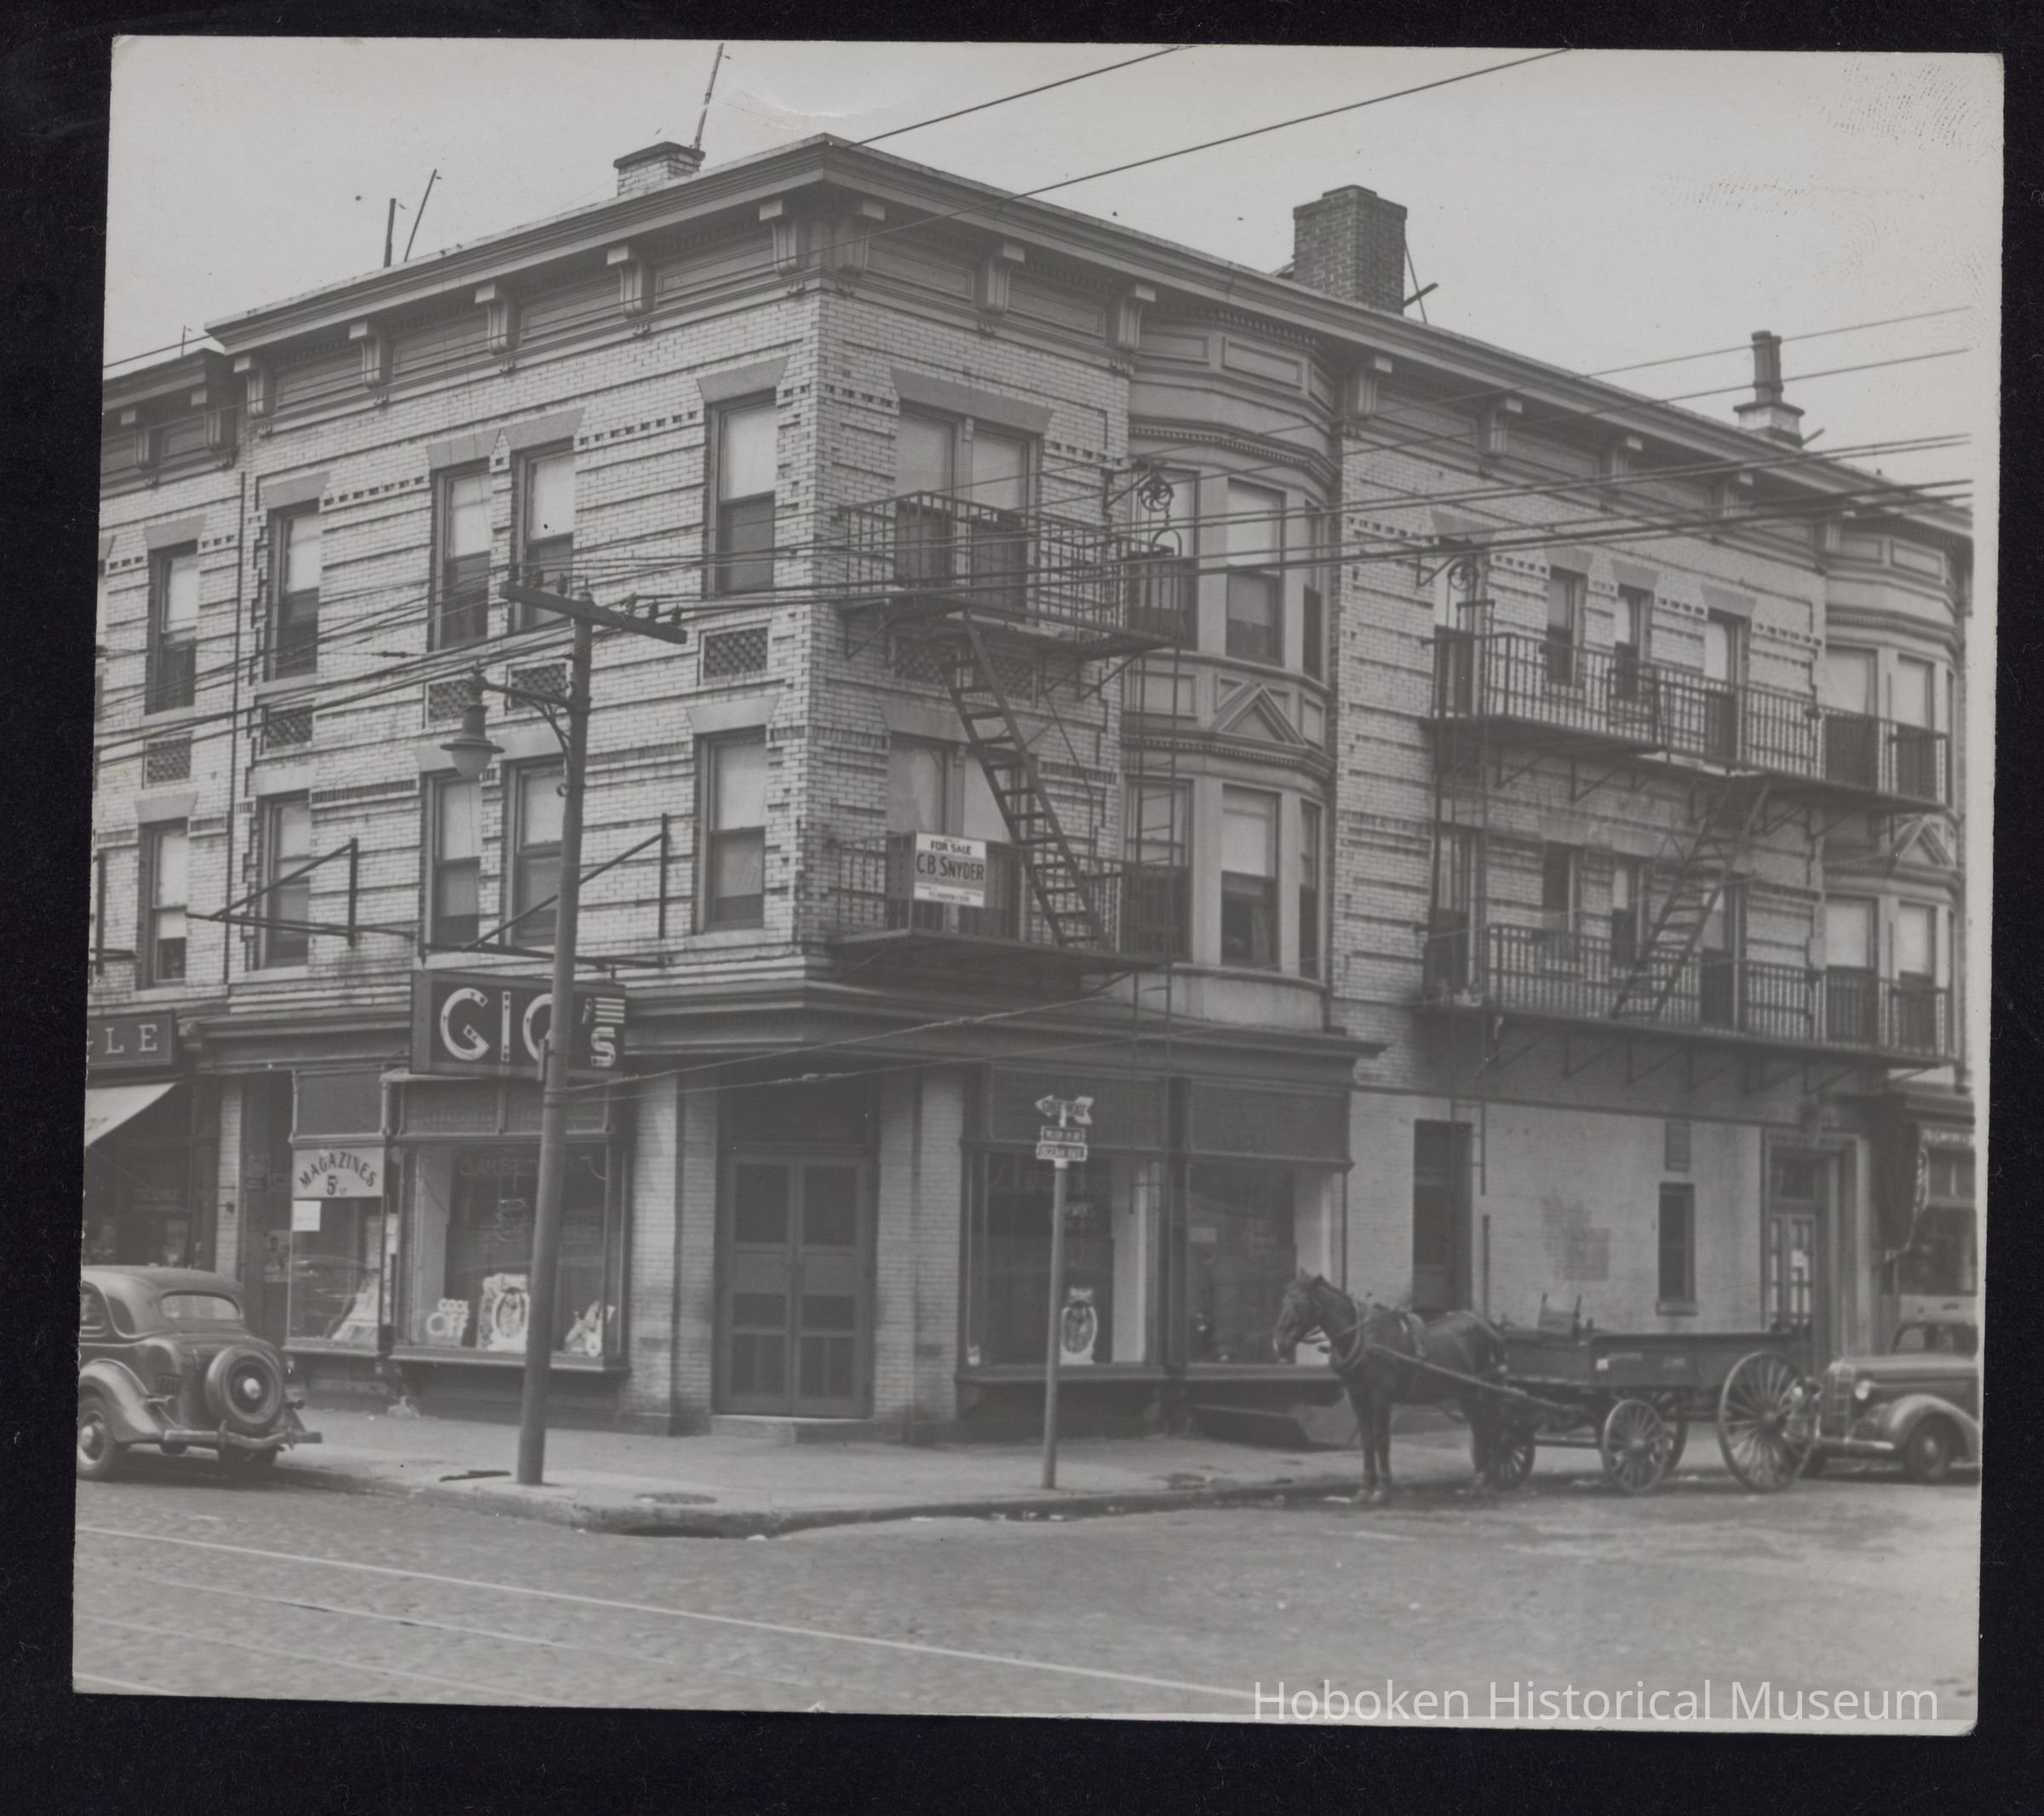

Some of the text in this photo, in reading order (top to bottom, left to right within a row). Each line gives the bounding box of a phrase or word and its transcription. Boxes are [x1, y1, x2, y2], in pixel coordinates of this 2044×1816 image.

[930, 840, 972, 855] FOR SALE
[939, 856, 985, 882] SNYDER
[87, 1023, 158, 1055] LE
[298, 1152, 376, 1189] MAGAZINES
